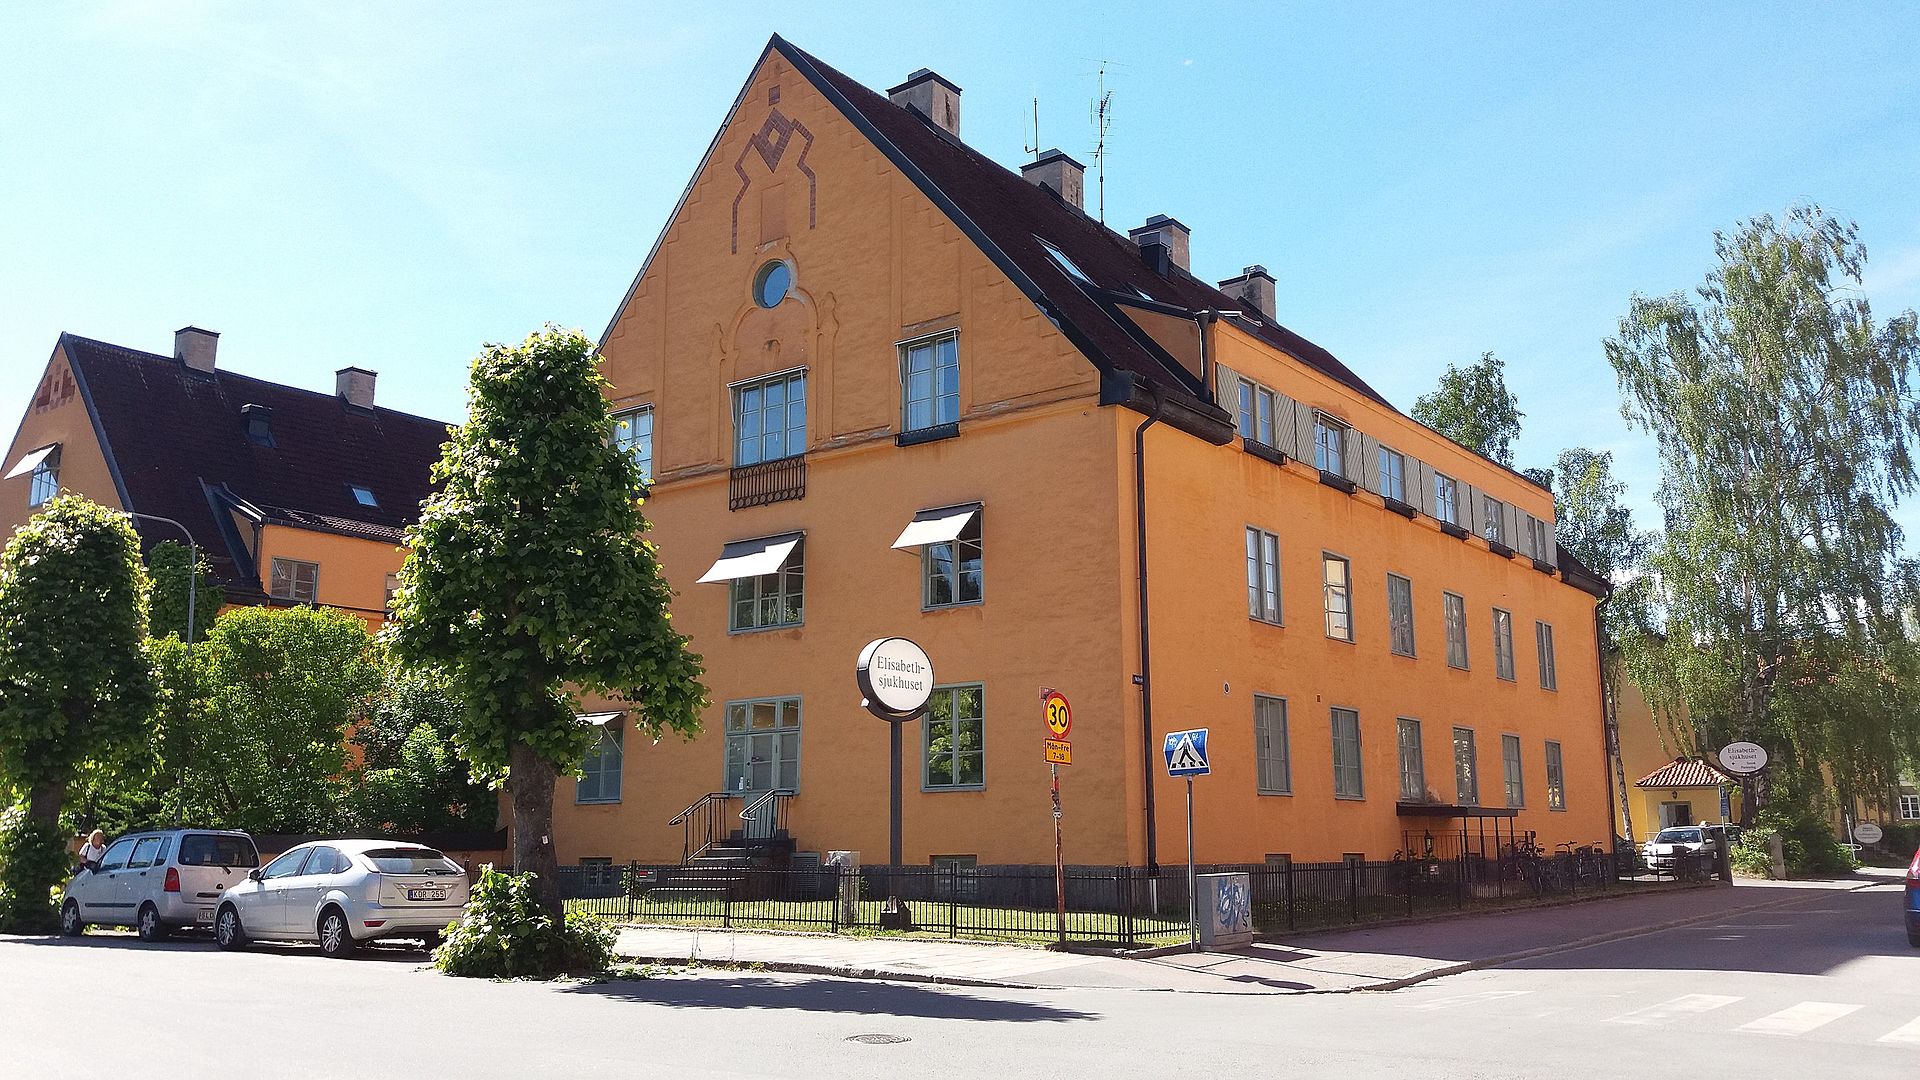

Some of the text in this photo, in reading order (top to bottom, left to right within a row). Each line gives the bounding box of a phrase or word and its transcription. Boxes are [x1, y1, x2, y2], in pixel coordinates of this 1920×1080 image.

[877, 656, 925, 674] Elisabeth-
[878, 674, 923, 691] sjukhuset
[1049, 703, 1068, 728] 30
